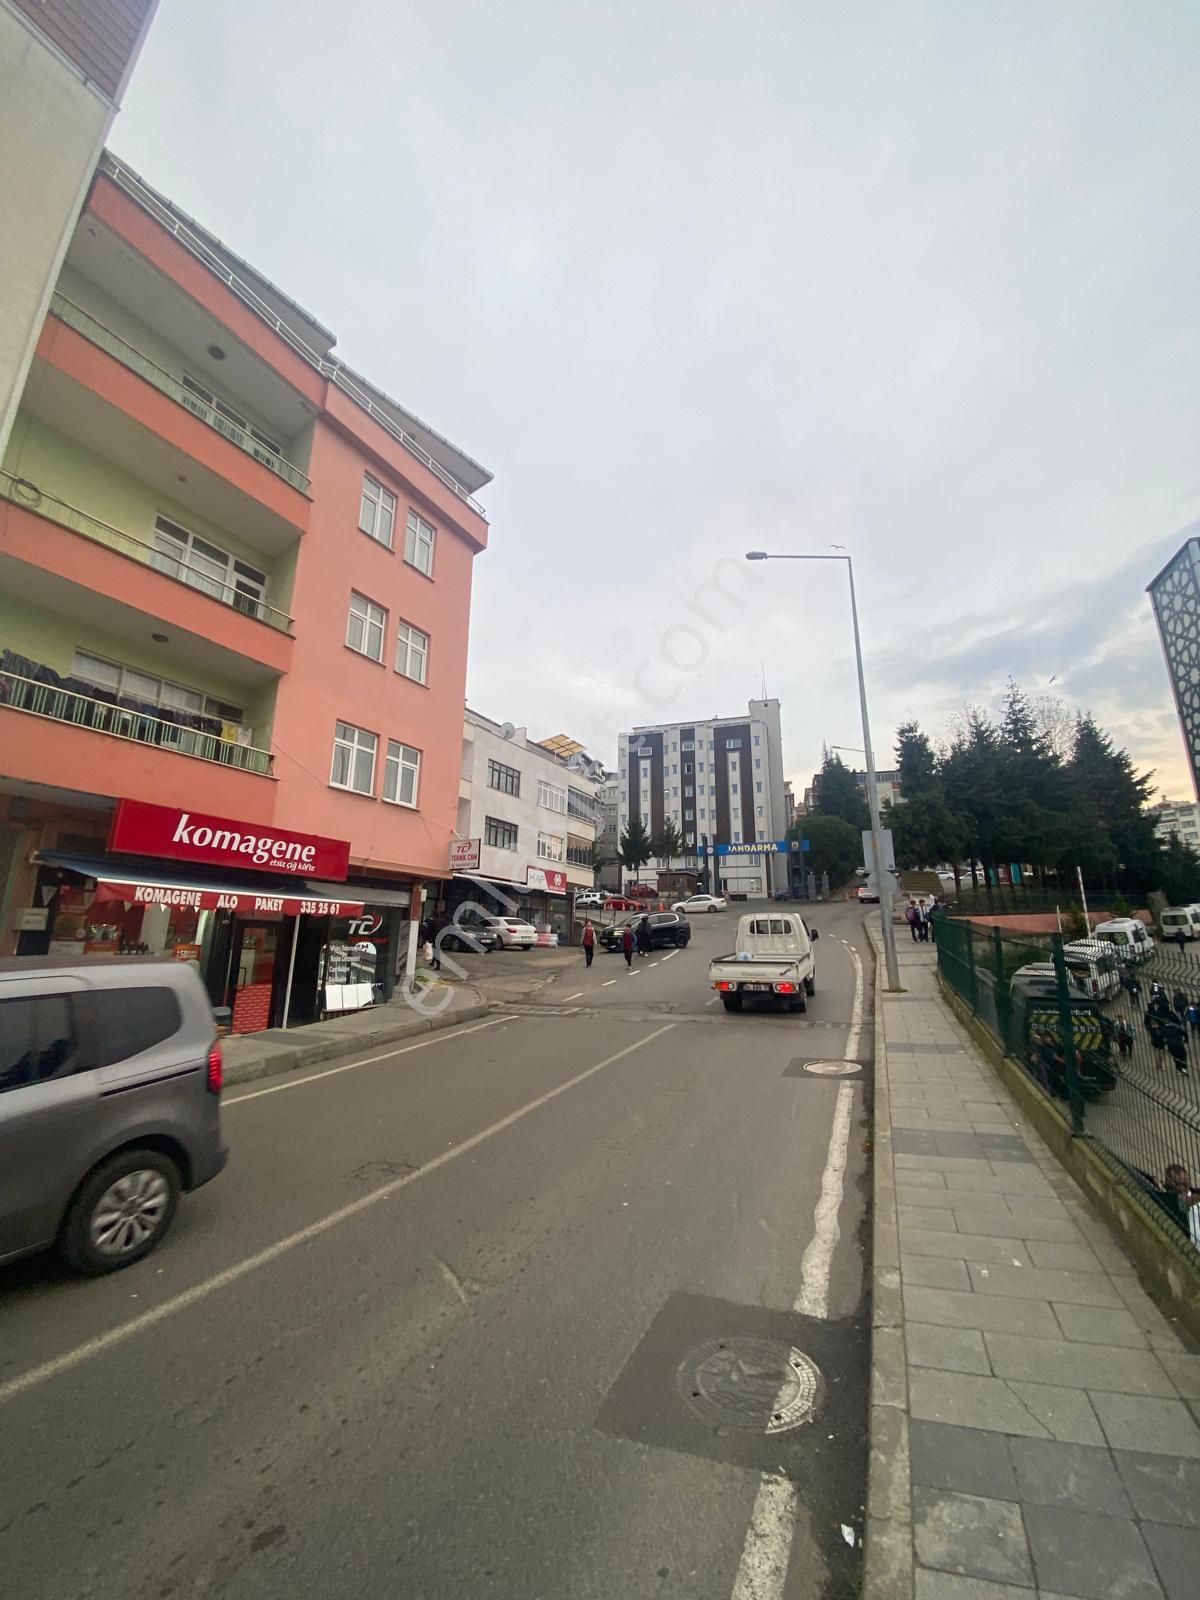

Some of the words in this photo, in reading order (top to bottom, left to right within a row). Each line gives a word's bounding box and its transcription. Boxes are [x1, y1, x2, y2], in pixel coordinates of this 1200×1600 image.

[172, 814, 316, 864] komagene
[270, 860, 286, 868] etsiz
[298, 862, 316, 872] köfte
[134, 886, 202, 906] KOMAGENE
[216, 894, 238, 909] ALO
[255, 897, 284, 912] PAKET
[300, 901, 316, 914] 335
[317, 902, 329, 915] 25
[329, 903, 340, 915] 61
[348, 918, 375, 935] TC
